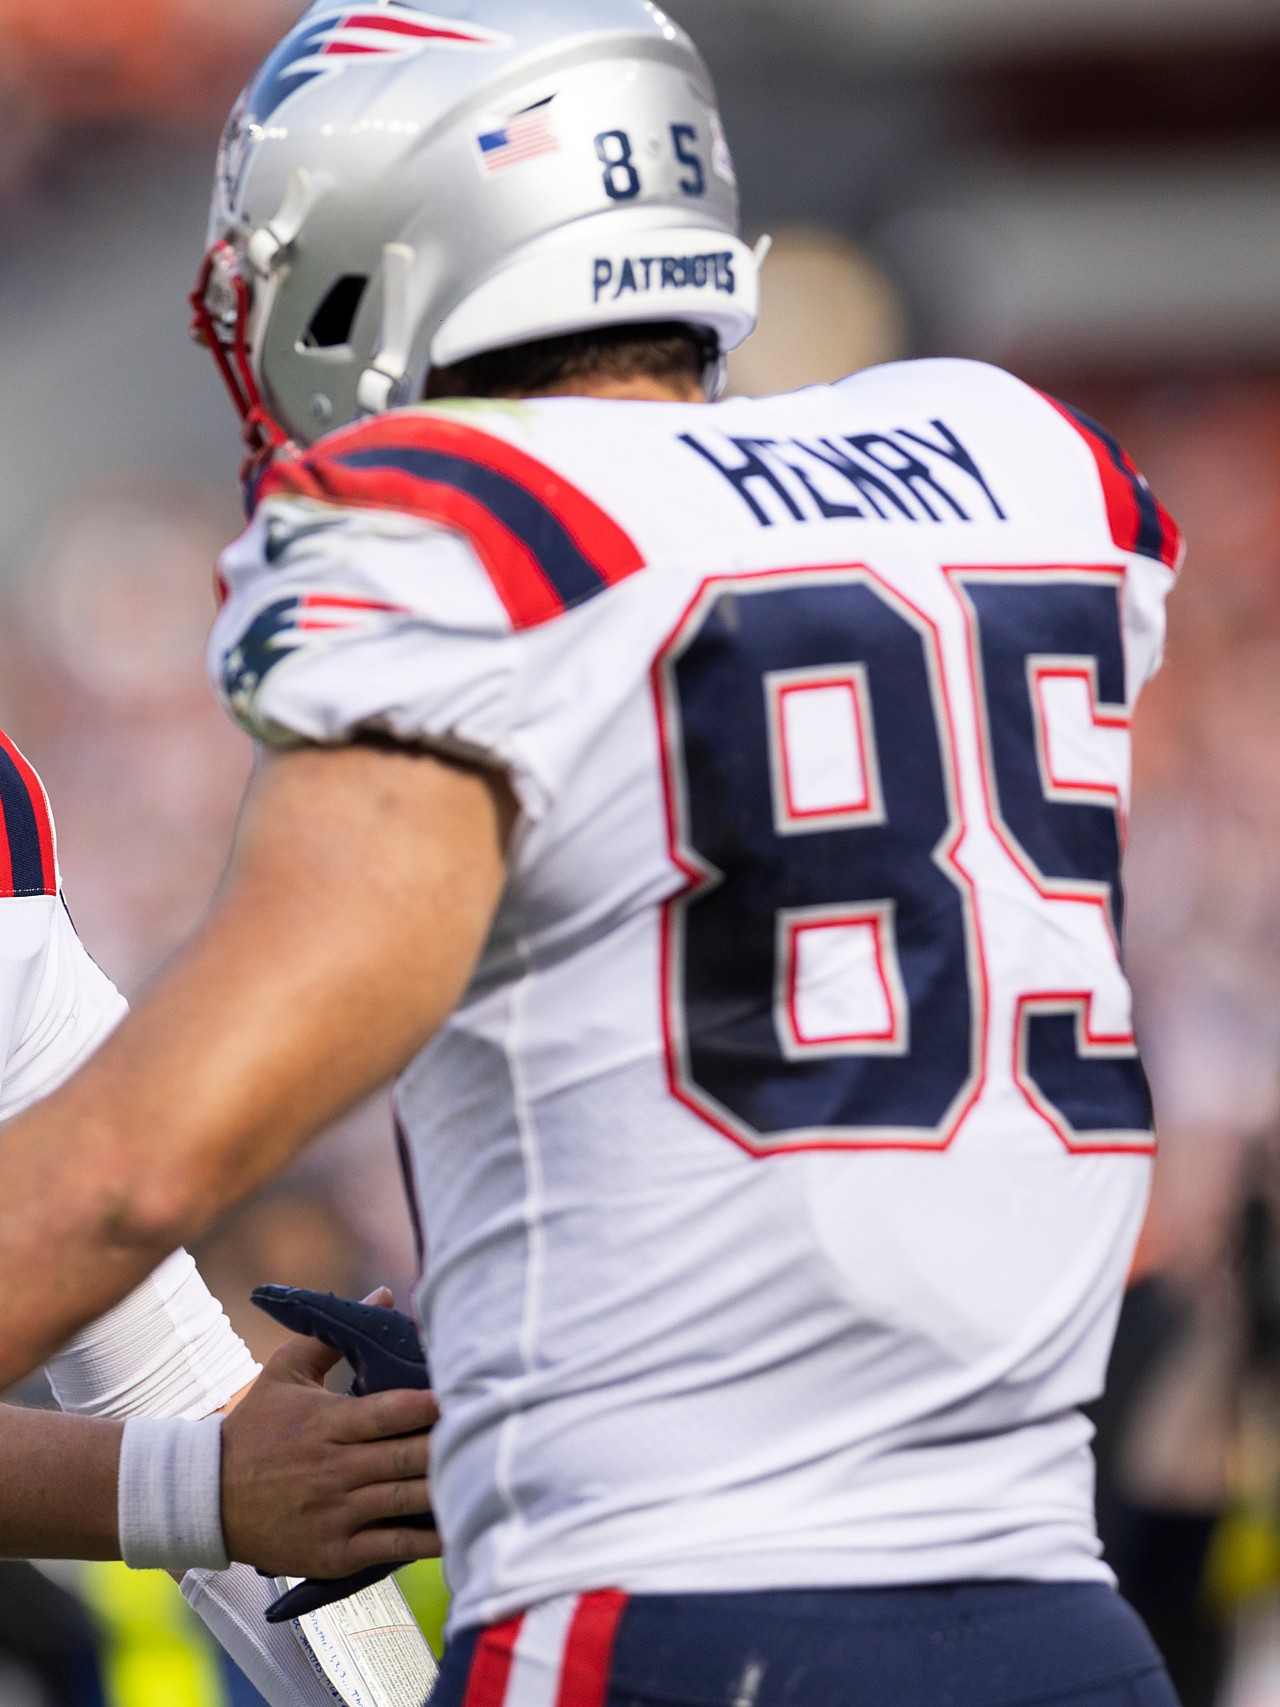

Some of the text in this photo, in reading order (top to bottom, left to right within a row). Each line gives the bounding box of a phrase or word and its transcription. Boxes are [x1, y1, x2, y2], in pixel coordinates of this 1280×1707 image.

[592, 251, 735, 303] PATRIOTS
[676, 419, 1007, 527] HENRY
[650, 563, 1158, 1158] 85
